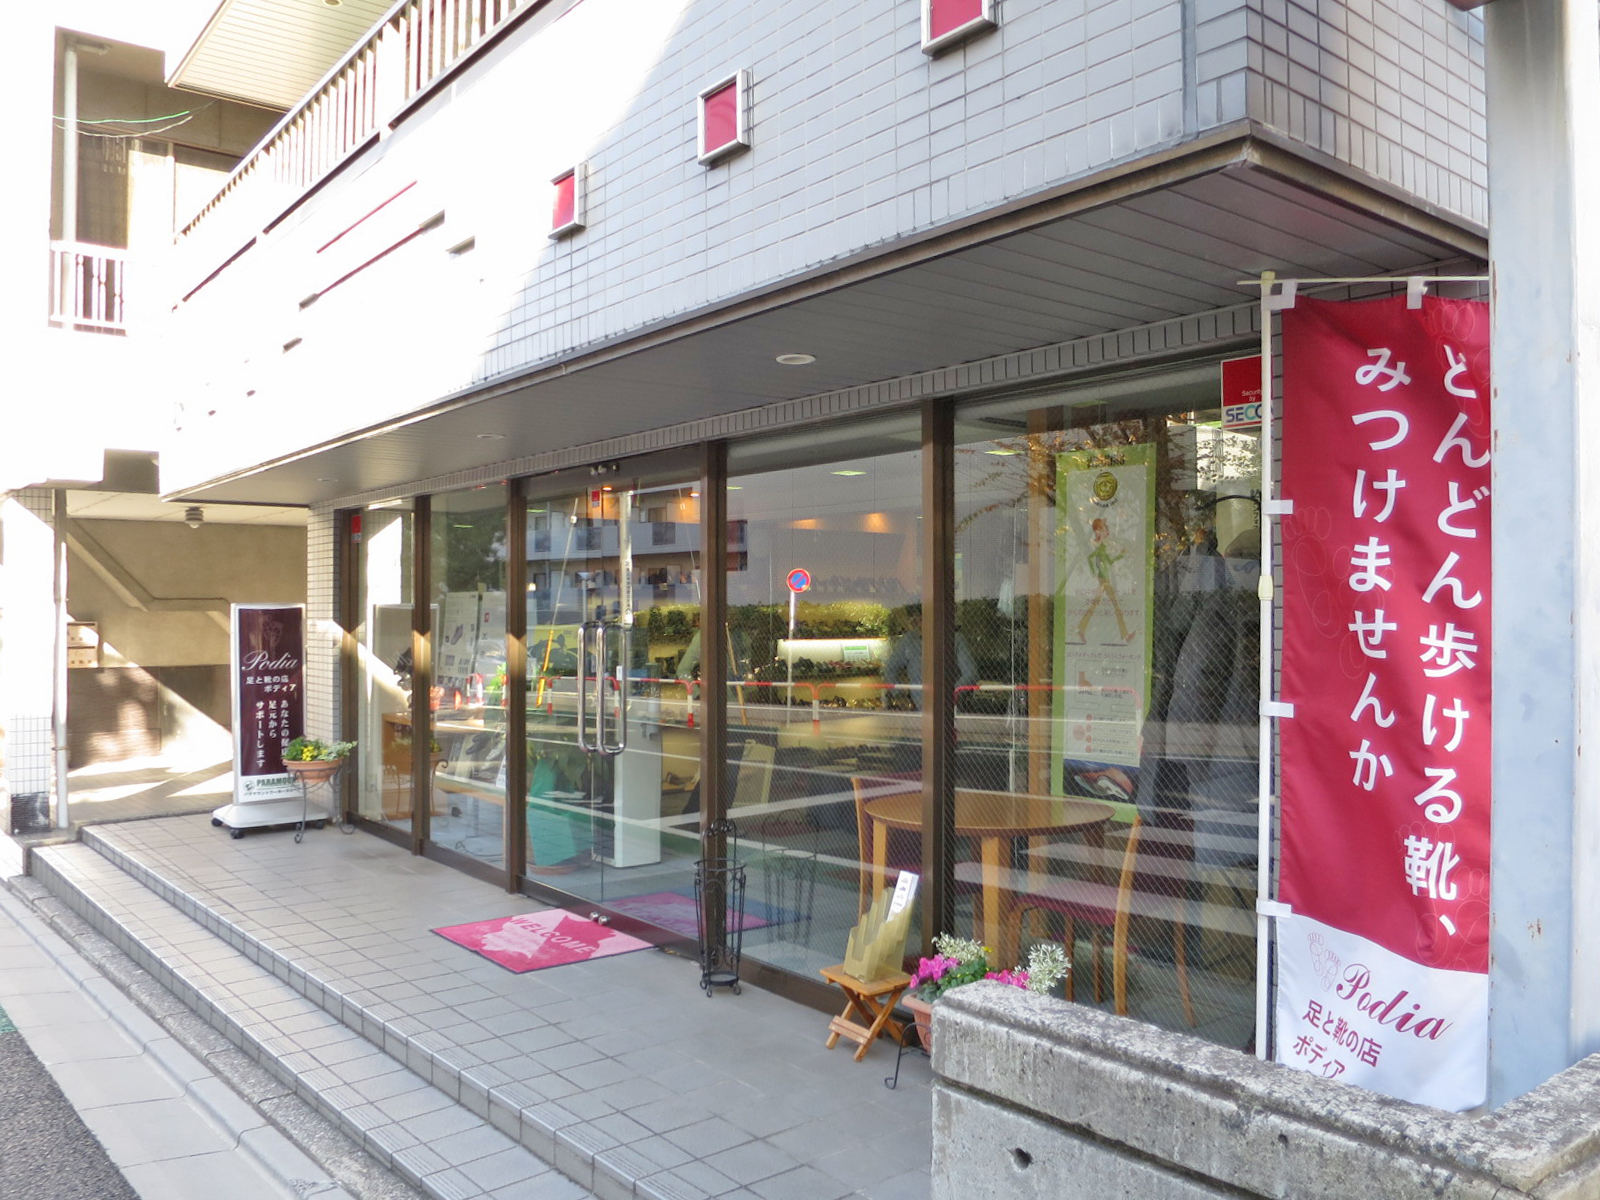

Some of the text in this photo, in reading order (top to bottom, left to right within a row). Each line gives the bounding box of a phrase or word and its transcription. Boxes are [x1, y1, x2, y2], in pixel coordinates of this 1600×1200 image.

[1348, 347, 1411, 791] みつけませんか
[241, 650, 298, 671] Podia
[246, 674, 289, 685] 足と靴の店
[264, 684, 297, 693] ポディア
[255, 700, 265, 769] サポートします
[268, 700, 278, 739] 足元から
[512, 917, 597, 953] WELCOME
[1336, 963, 1454, 1041] Podia
[1302, 999, 1383, 1068] 足と靴の店
[1292, 1035, 1346, 1079] ポディア
